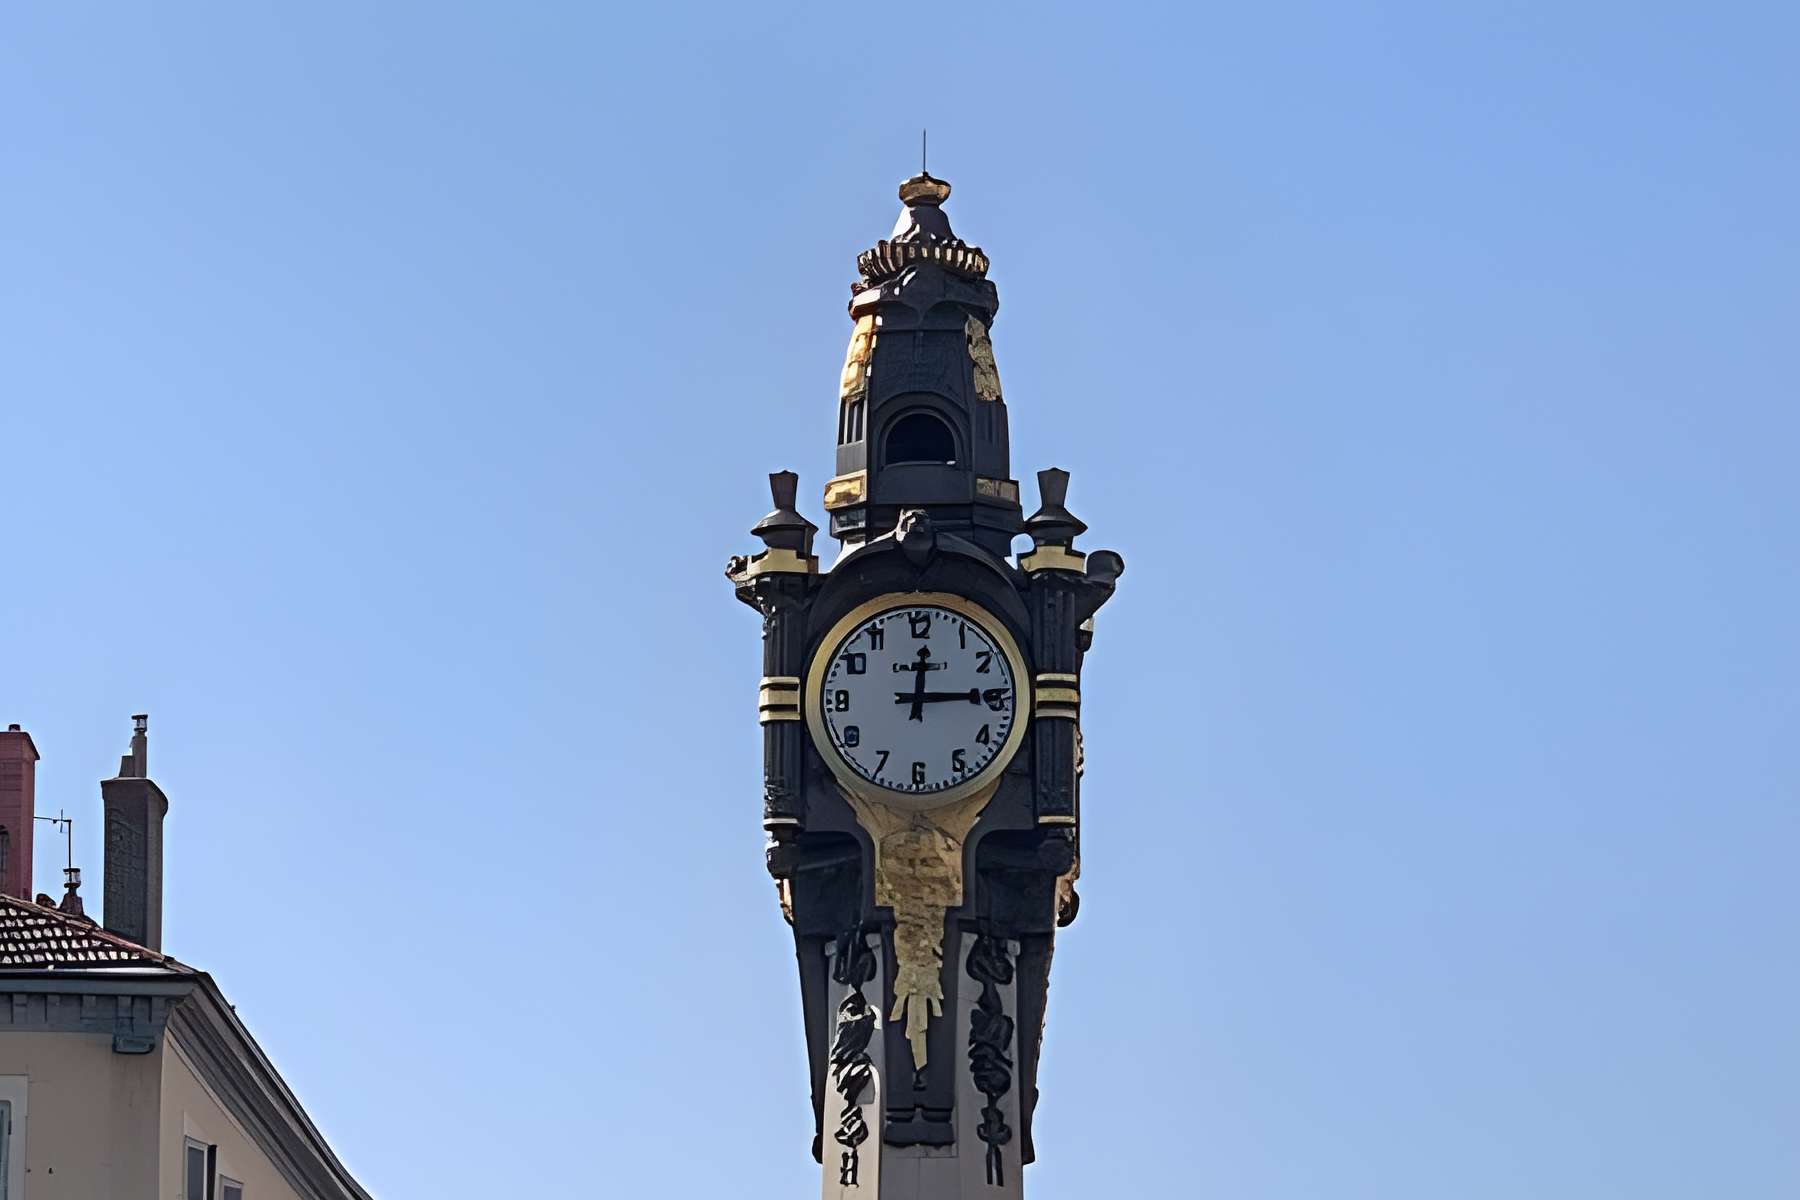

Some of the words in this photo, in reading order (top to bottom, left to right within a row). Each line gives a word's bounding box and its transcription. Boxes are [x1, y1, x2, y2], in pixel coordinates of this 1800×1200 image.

[908, 611, 931, 639] 12
[959, 620, 966, 649] 1
[975, 651, 993, 673] 2
[975, 724, 989, 746] 4
[873, 751, 890, 780] 7
[912, 762, 926, 784] 6
